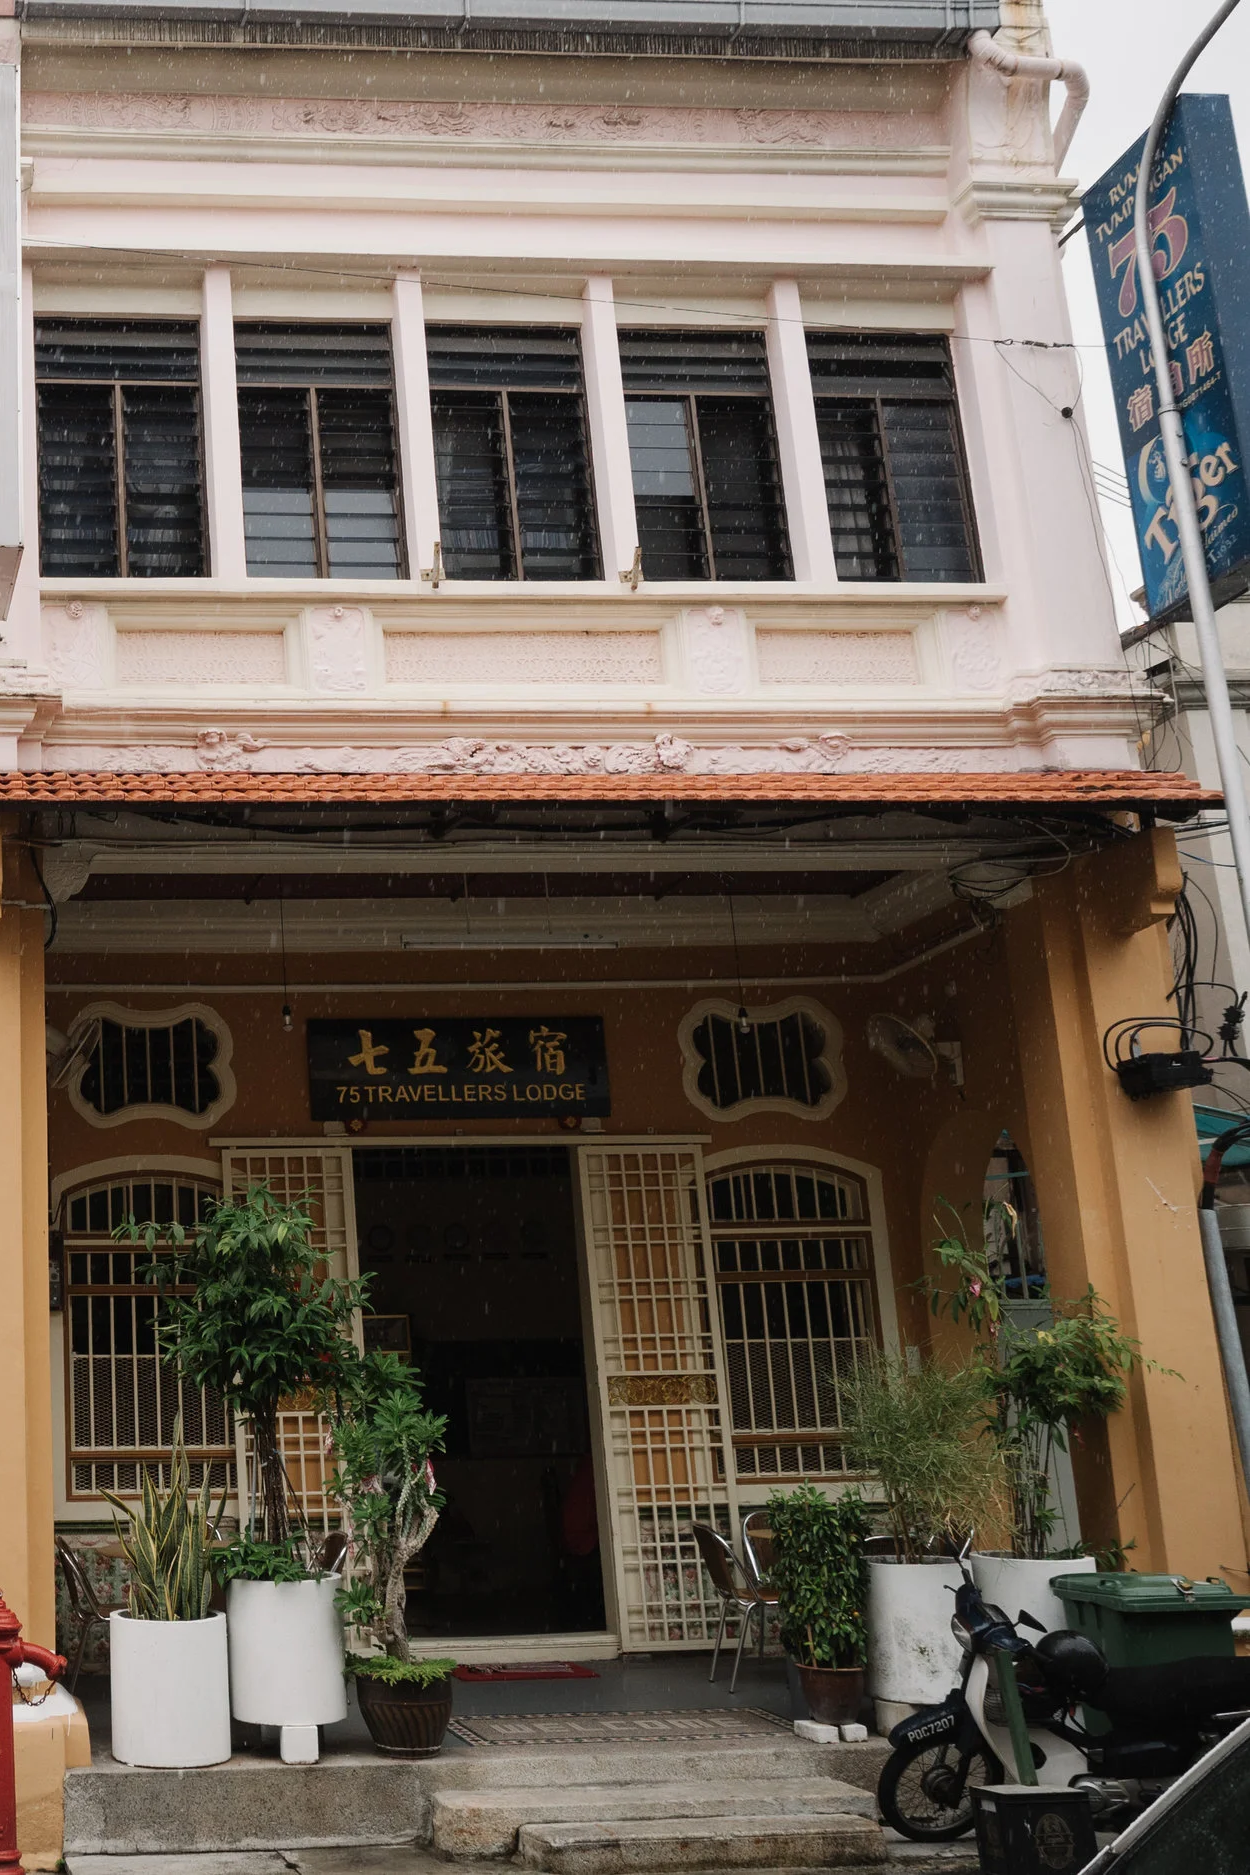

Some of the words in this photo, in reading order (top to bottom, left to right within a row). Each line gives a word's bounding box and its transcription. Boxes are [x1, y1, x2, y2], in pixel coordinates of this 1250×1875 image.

[1095, 146, 1183, 243] TUMPGAN
[1107, 186, 1189, 318] 75
[1112, 261, 1205, 361] TRAVLLERS
[1139, 312, 1189, 375] LOGE
[347, 1025, 568, 1076] 七五旅宿
[336, 1086, 361, 1104] 75
[364, 1084, 507, 1103] TRAVELLERS
[513, 1083, 586, 1102] LODGE
[489, 1717, 748, 1735] WELCOME
